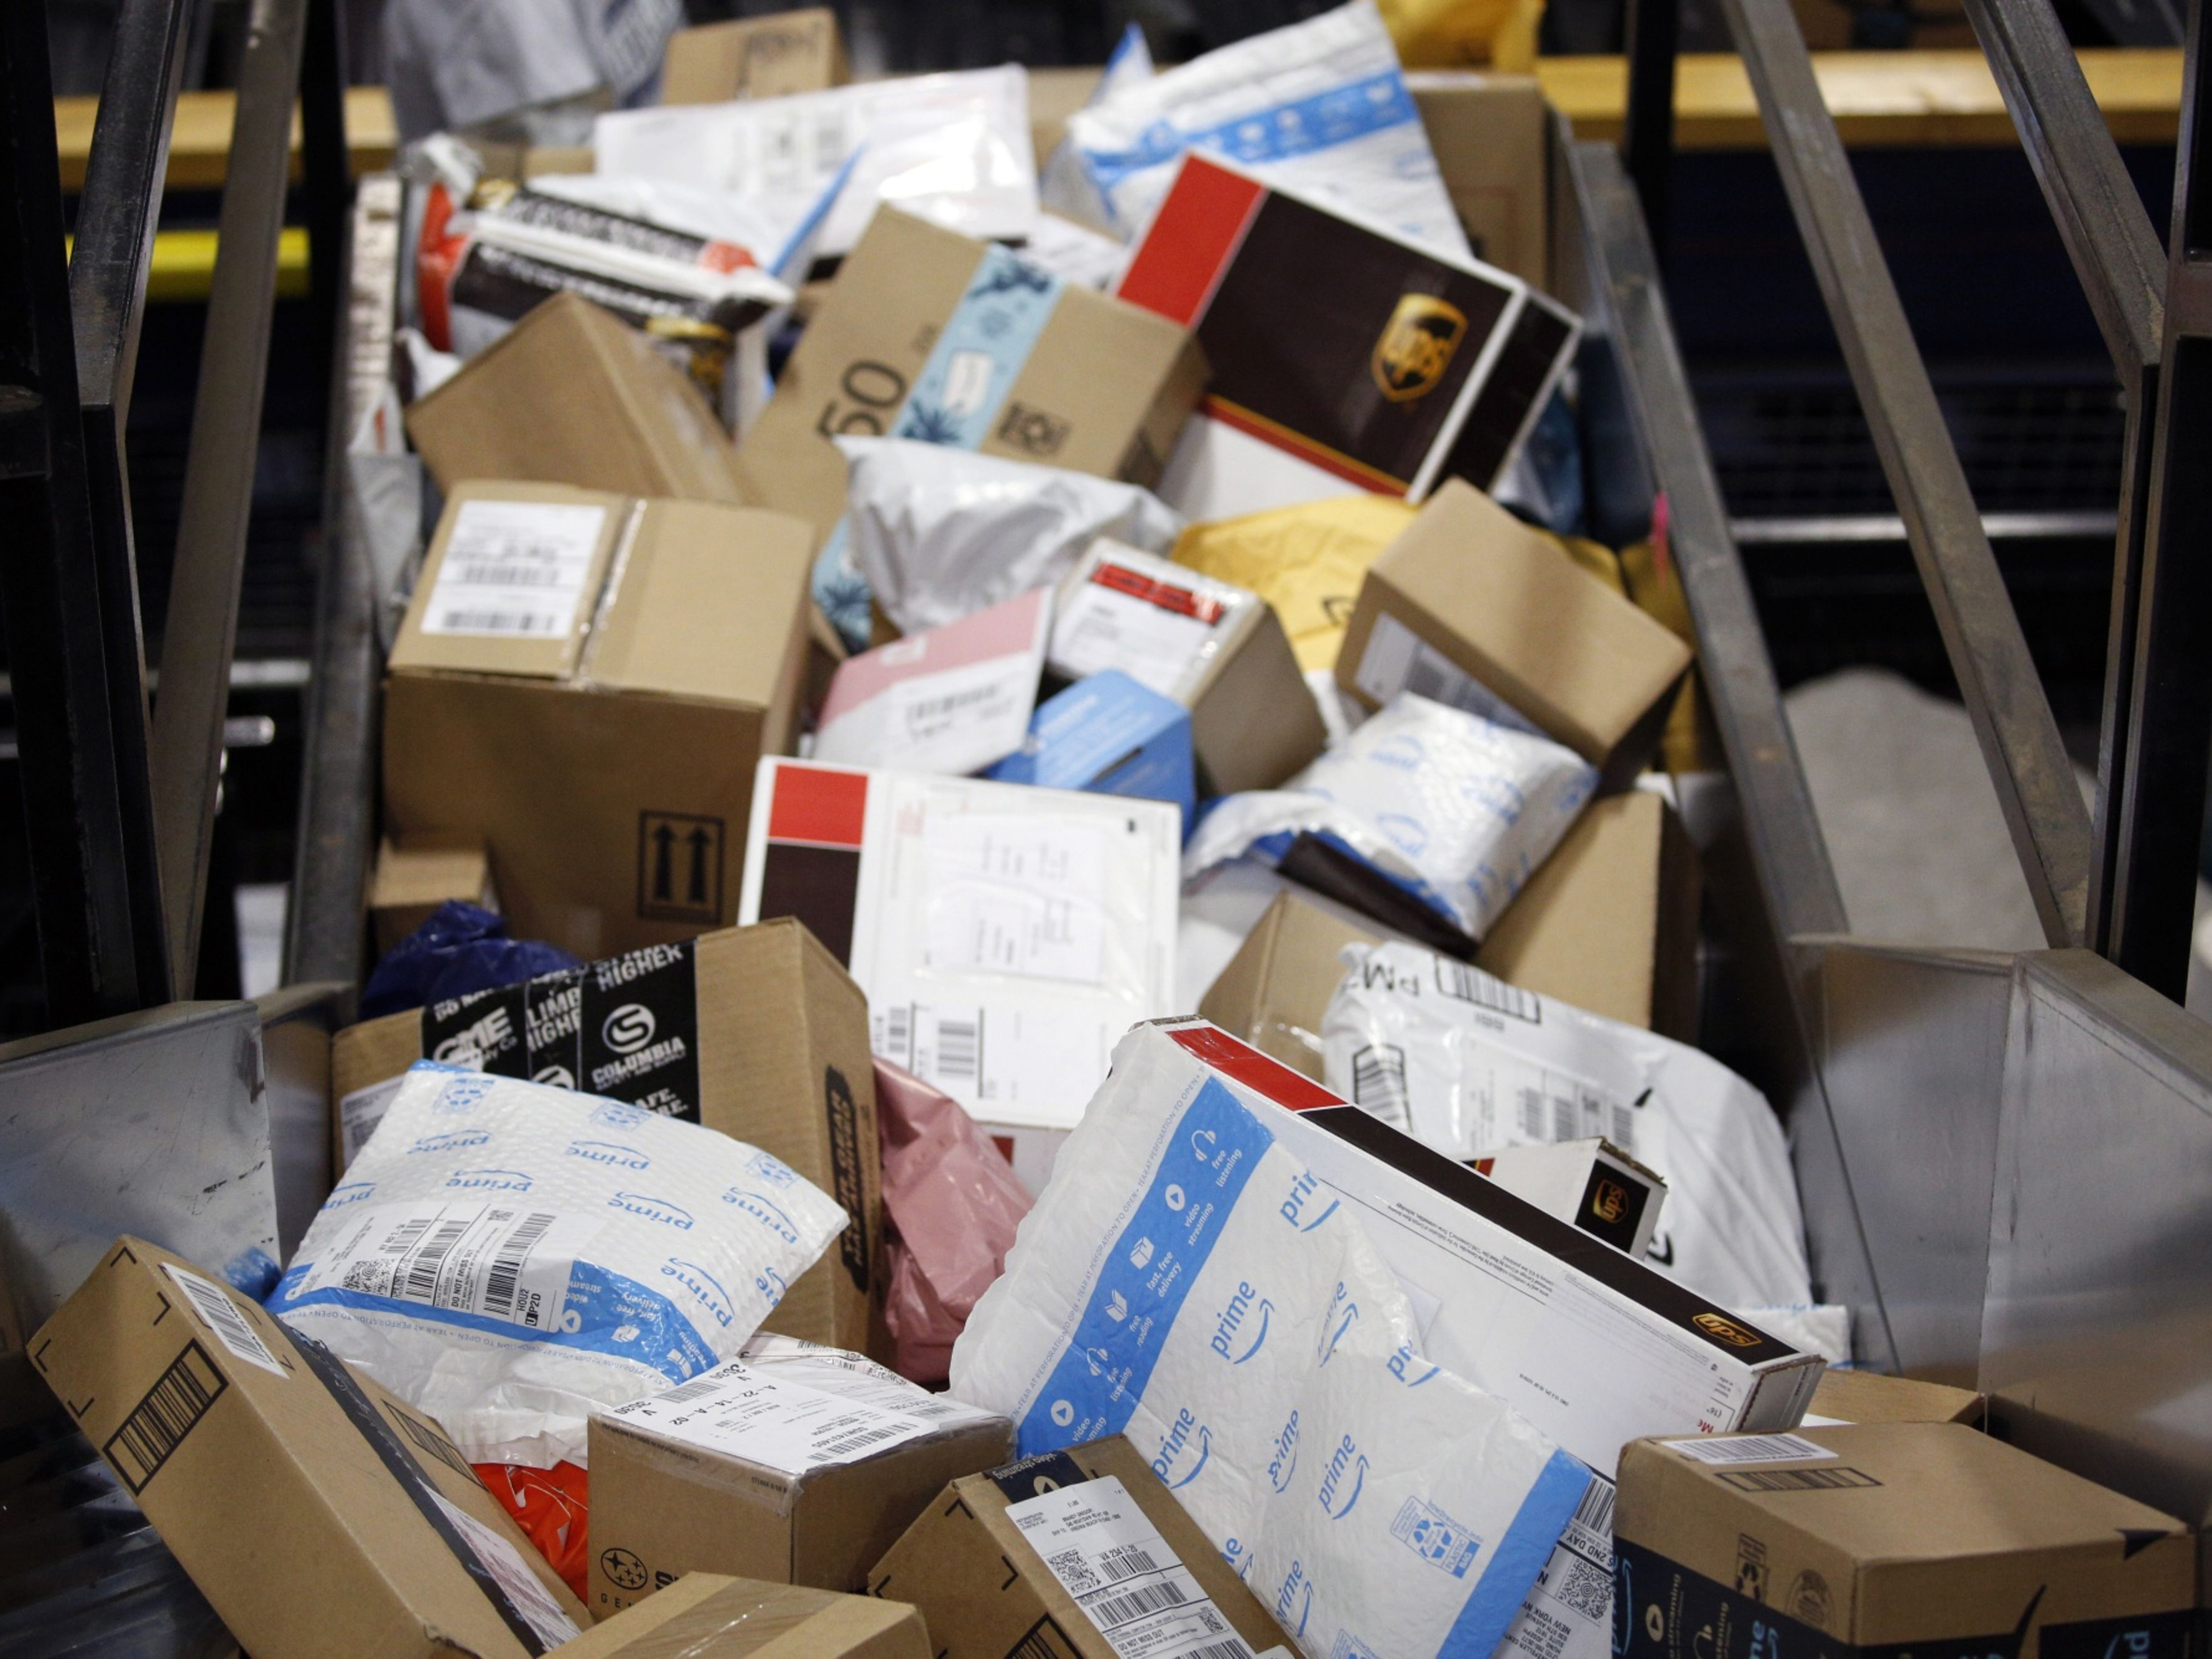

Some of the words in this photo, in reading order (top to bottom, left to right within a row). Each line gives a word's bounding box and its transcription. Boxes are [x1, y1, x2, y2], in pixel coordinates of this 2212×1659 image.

[592, 1036, 686, 1085] COLUMBIA
[407, 1135, 490, 1155] prime
[564, 1146, 650, 1171] prime
[1211, 1149, 1227, 1170] free
[1216, 1148, 1242, 1187] listening
[445, 1176, 534, 1192] prime
[607, 1199, 694, 1231] prime
[723, 1192, 798, 1244] prime
[1184, 1204, 1200, 1229] video
[1188, 1202, 1214, 1246] streaming
[1018, 1388, 1031, 1410] TEAR
[1031, 1376, 1038, 1388] AT
[1036, 1331, 1067, 1380] PERFORATION
[1077, 1279, 1088, 1298] TEAR
[1090, 1223, 1119, 1271] PERFORATION
[1117, 1212, 1126, 1225] TO
[1123, 1192, 1139, 1214] OPEN
[1138, 1170, 1149, 1191] TEAR
[1150, 1112, 1176, 1163] PERFORATION
[1173, 1100, 1183, 1112] TO
[1181, 1078, 1198, 1100] OPEN
[1146, 1270, 1163, 1291] fast,
[1158, 1252, 1174, 1271] free
[1157, 1262, 1182, 1298] delivery
[518, 1288, 529, 1311] HOU2
[660, 1265, 733, 1327] prime
[425, 1326, 447, 1335] TEAR
[1129, 1314, 1141, 1332] free
[1211, 1281, 1256, 1361] prime
[457, 1332, 481, 1342] OPEN
[1072, 1417, 1091, 1442] video
[1150, 1407, 1195, 1485] prime
[1268, 1410, 1299, 1486] prime
[992, 1461, 1033, 1480] streaming
[1318, 1434, 1355, 1513] prime
[1566, 1532, 1587, 1550] DAY
[1445, 1539, 1466, 1569] PLASTIC
[1459, 1552, 1472, 1569] BAG
[1586, 1545, 1607, 1563] 2ND
[1533, 1607, 1554, 1624] YORK
[1552, 1620, 1571, 1635] NEW
